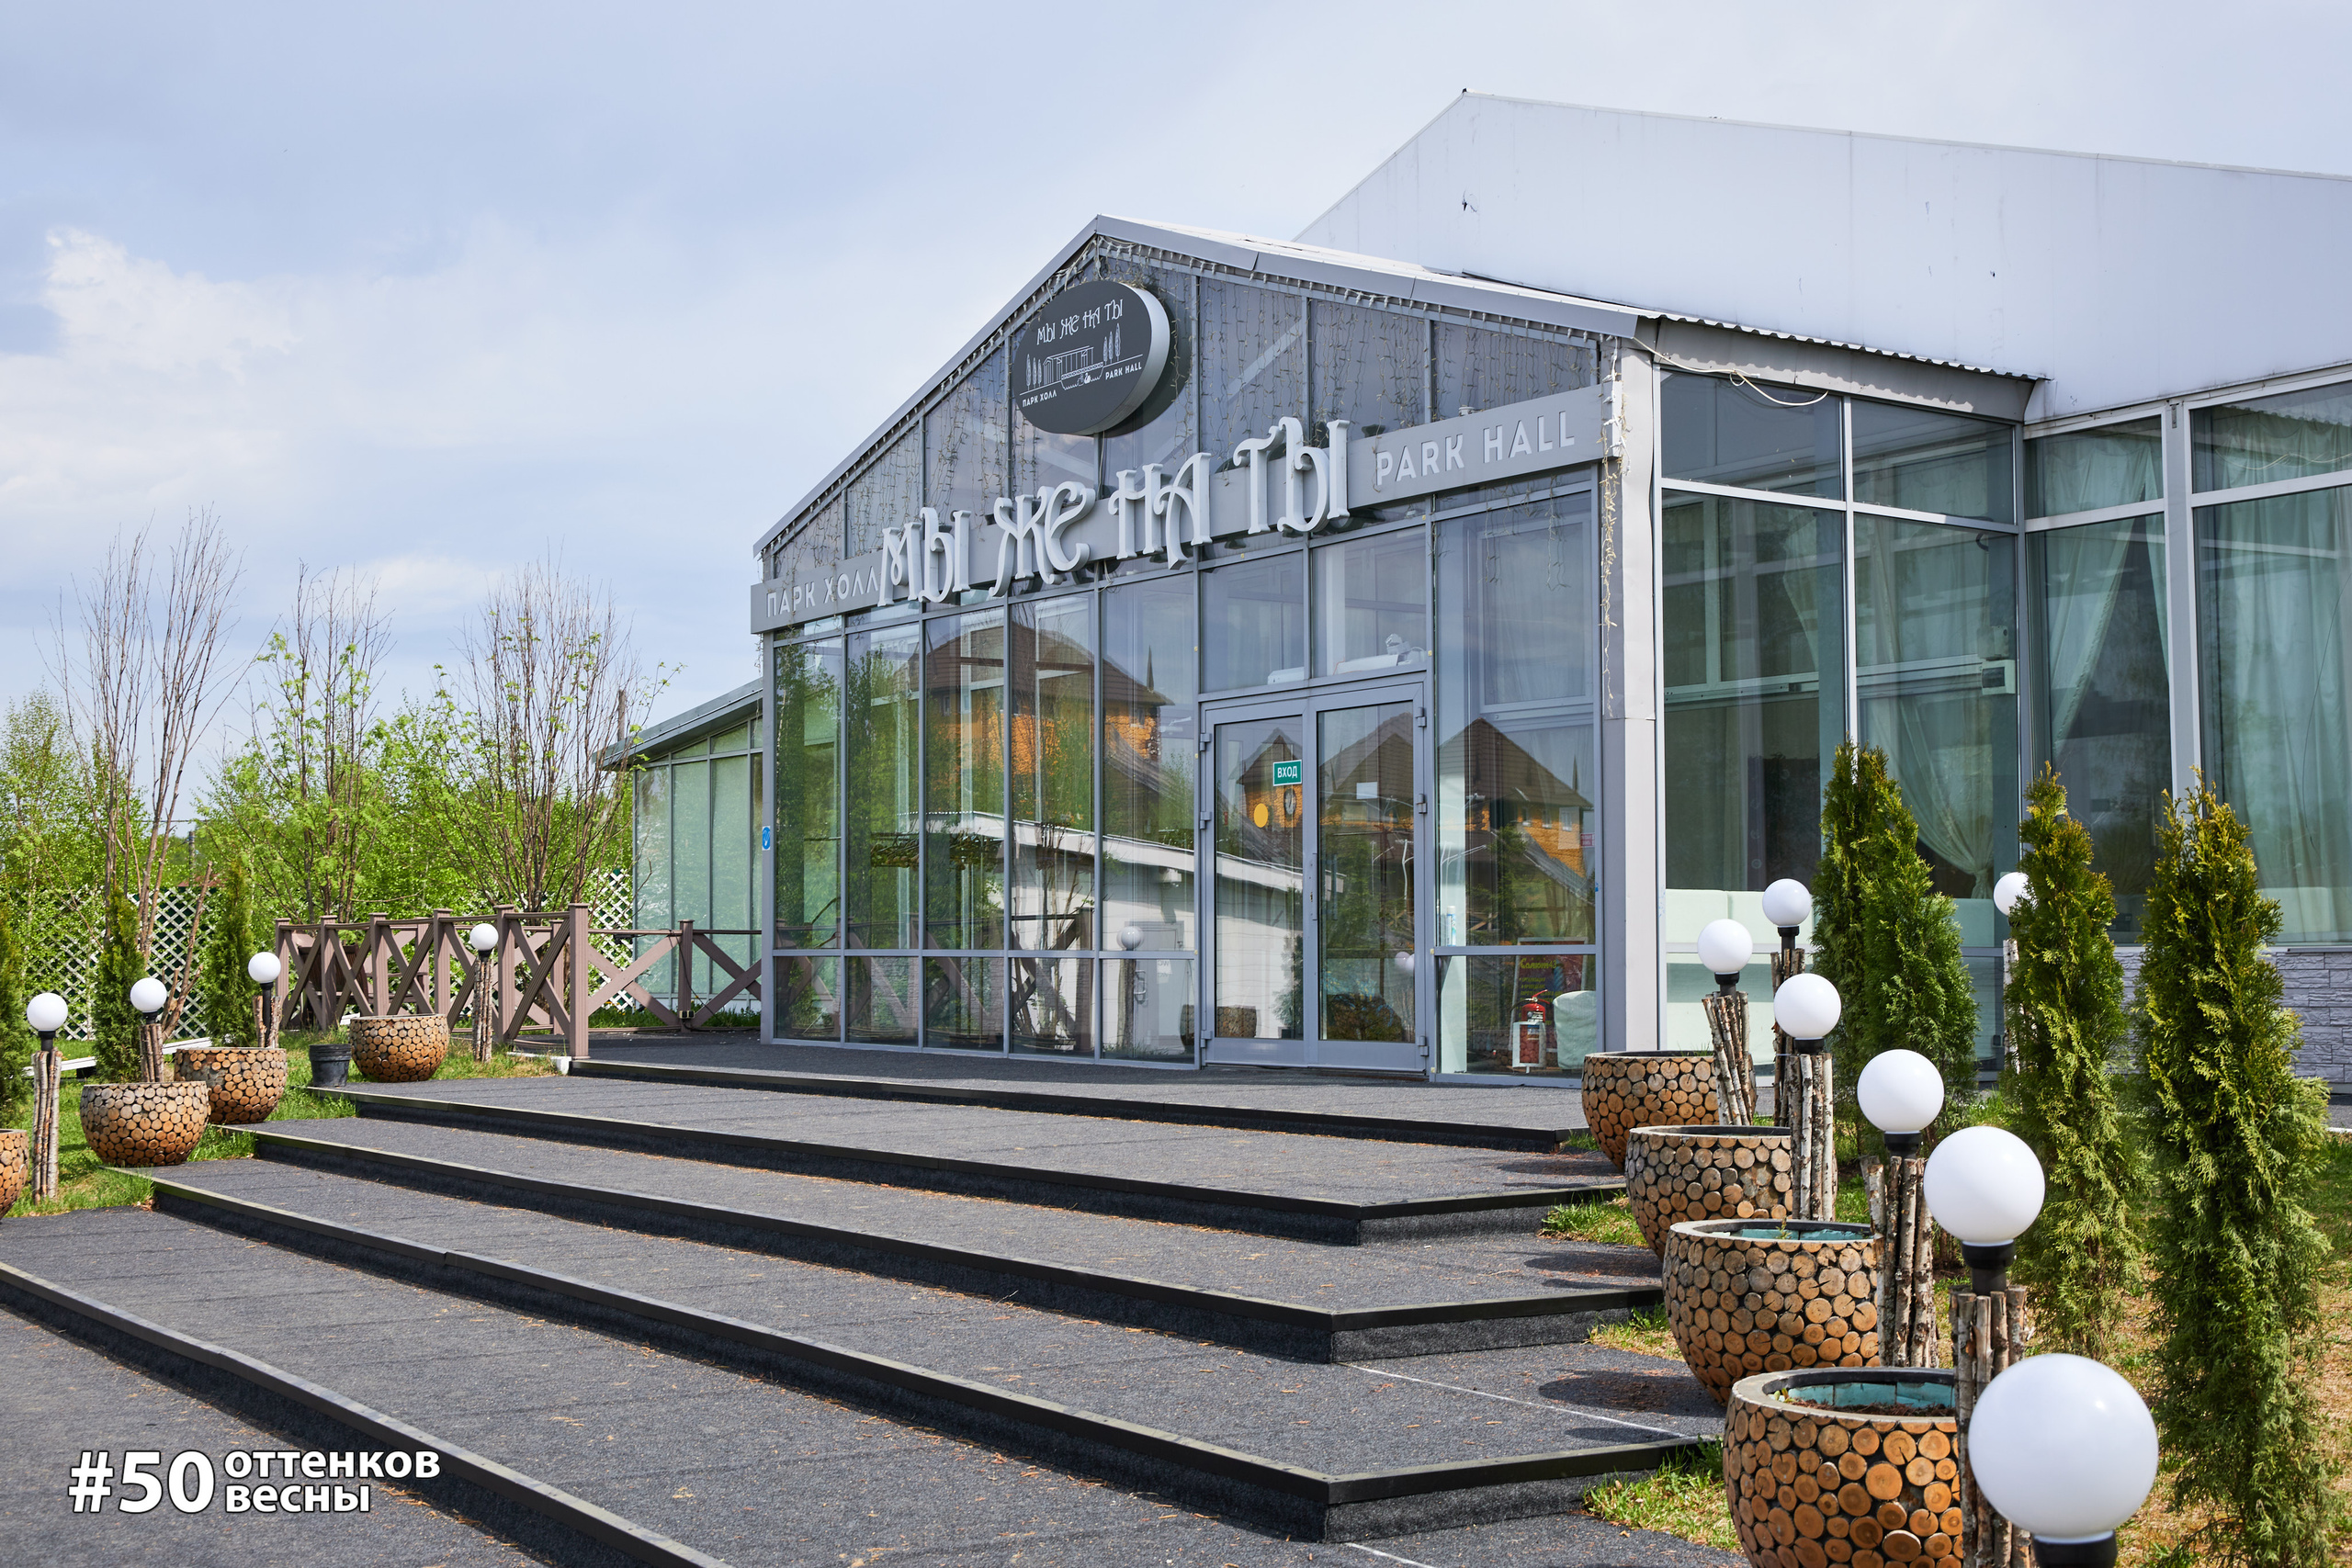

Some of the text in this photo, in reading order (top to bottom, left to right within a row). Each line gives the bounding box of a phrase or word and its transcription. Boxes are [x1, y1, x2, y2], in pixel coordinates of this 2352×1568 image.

[1036, 299, 1123, 345] МЫ ЖЕ НА ТЫ
[1105, 362, 1142, 380] PARK HALL
[1023, 389, 1057, 407] ПАРК ХОЛЛ
[1375, 410, 1575, 486] PARK HALL
[877, 416, 1350, 606] МЫ ЖЕ НА ТЫ
[766, 566, 879, 618] ПАРК ХОЛЛ
[1277, 765, 1297, 779] ВХОД
